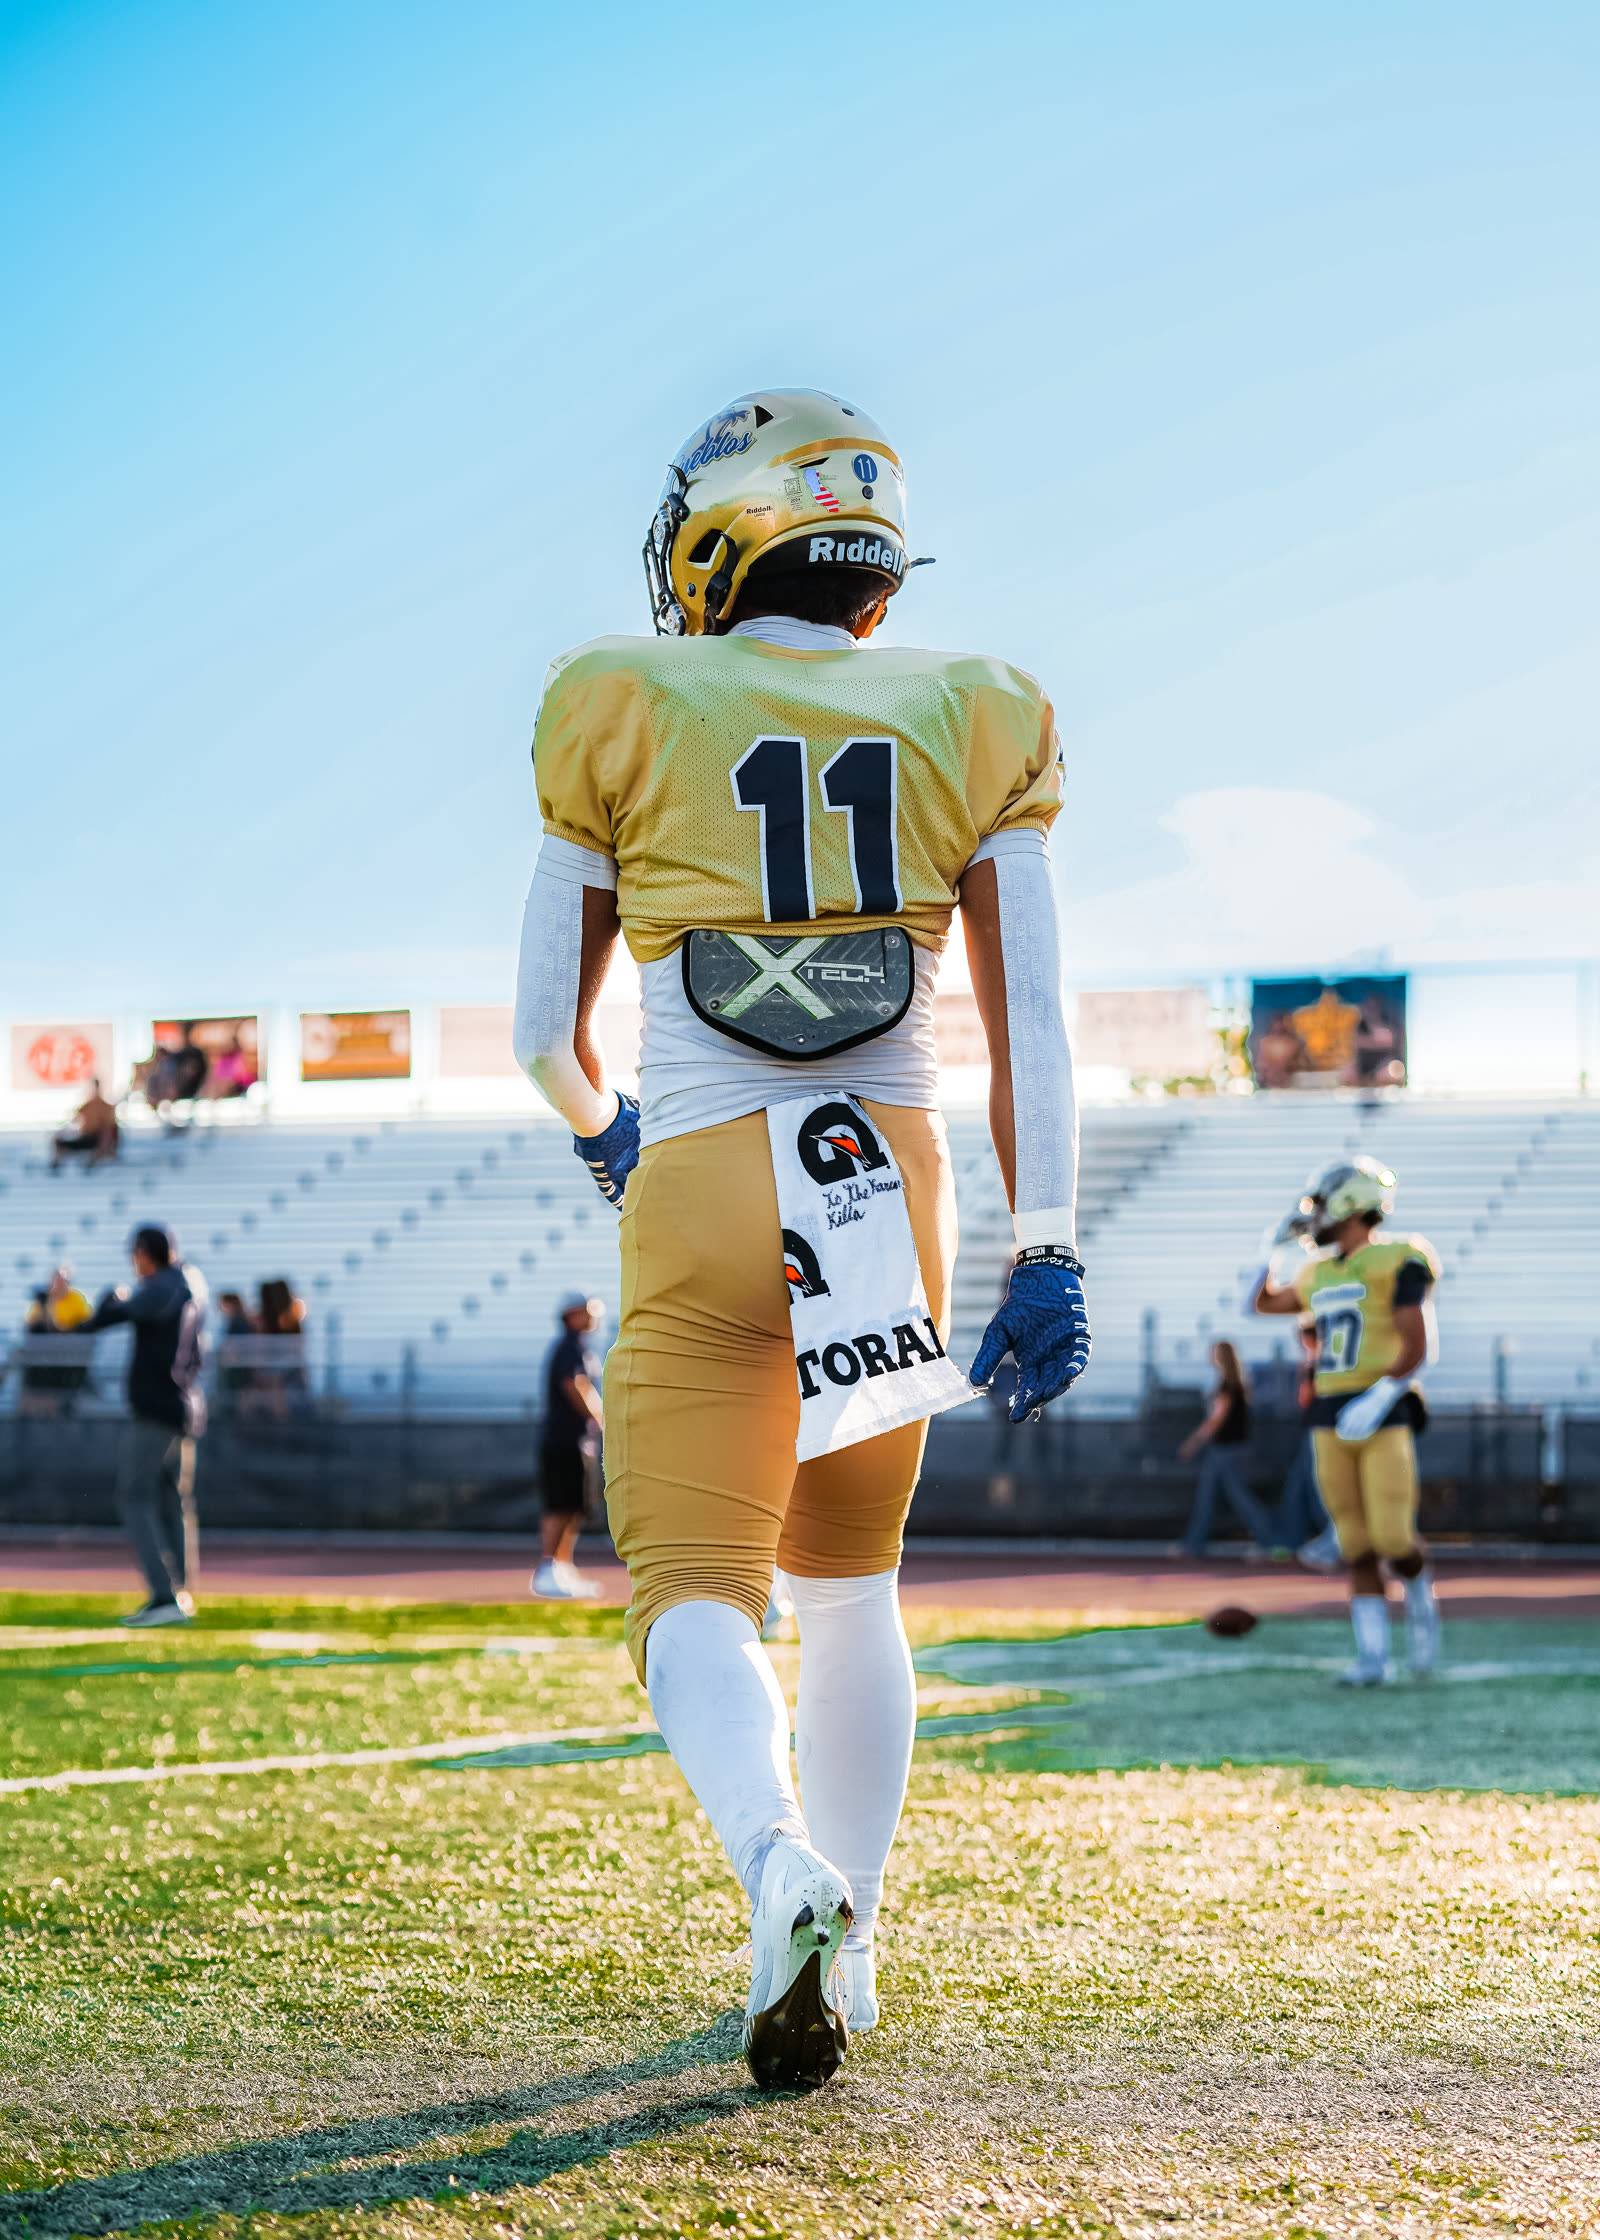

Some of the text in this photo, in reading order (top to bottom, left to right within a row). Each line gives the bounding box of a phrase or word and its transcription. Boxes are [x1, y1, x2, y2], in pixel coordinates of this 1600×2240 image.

[857, 456, 873, 480] 11
[746, 505, 772, 515] Riddell
[808, 536, 905, 577] Riddell
[729, 734, 904, 923] 11
[842, 1182, 870, 1205] The
[797, 1318, 945, 1401] TORA
